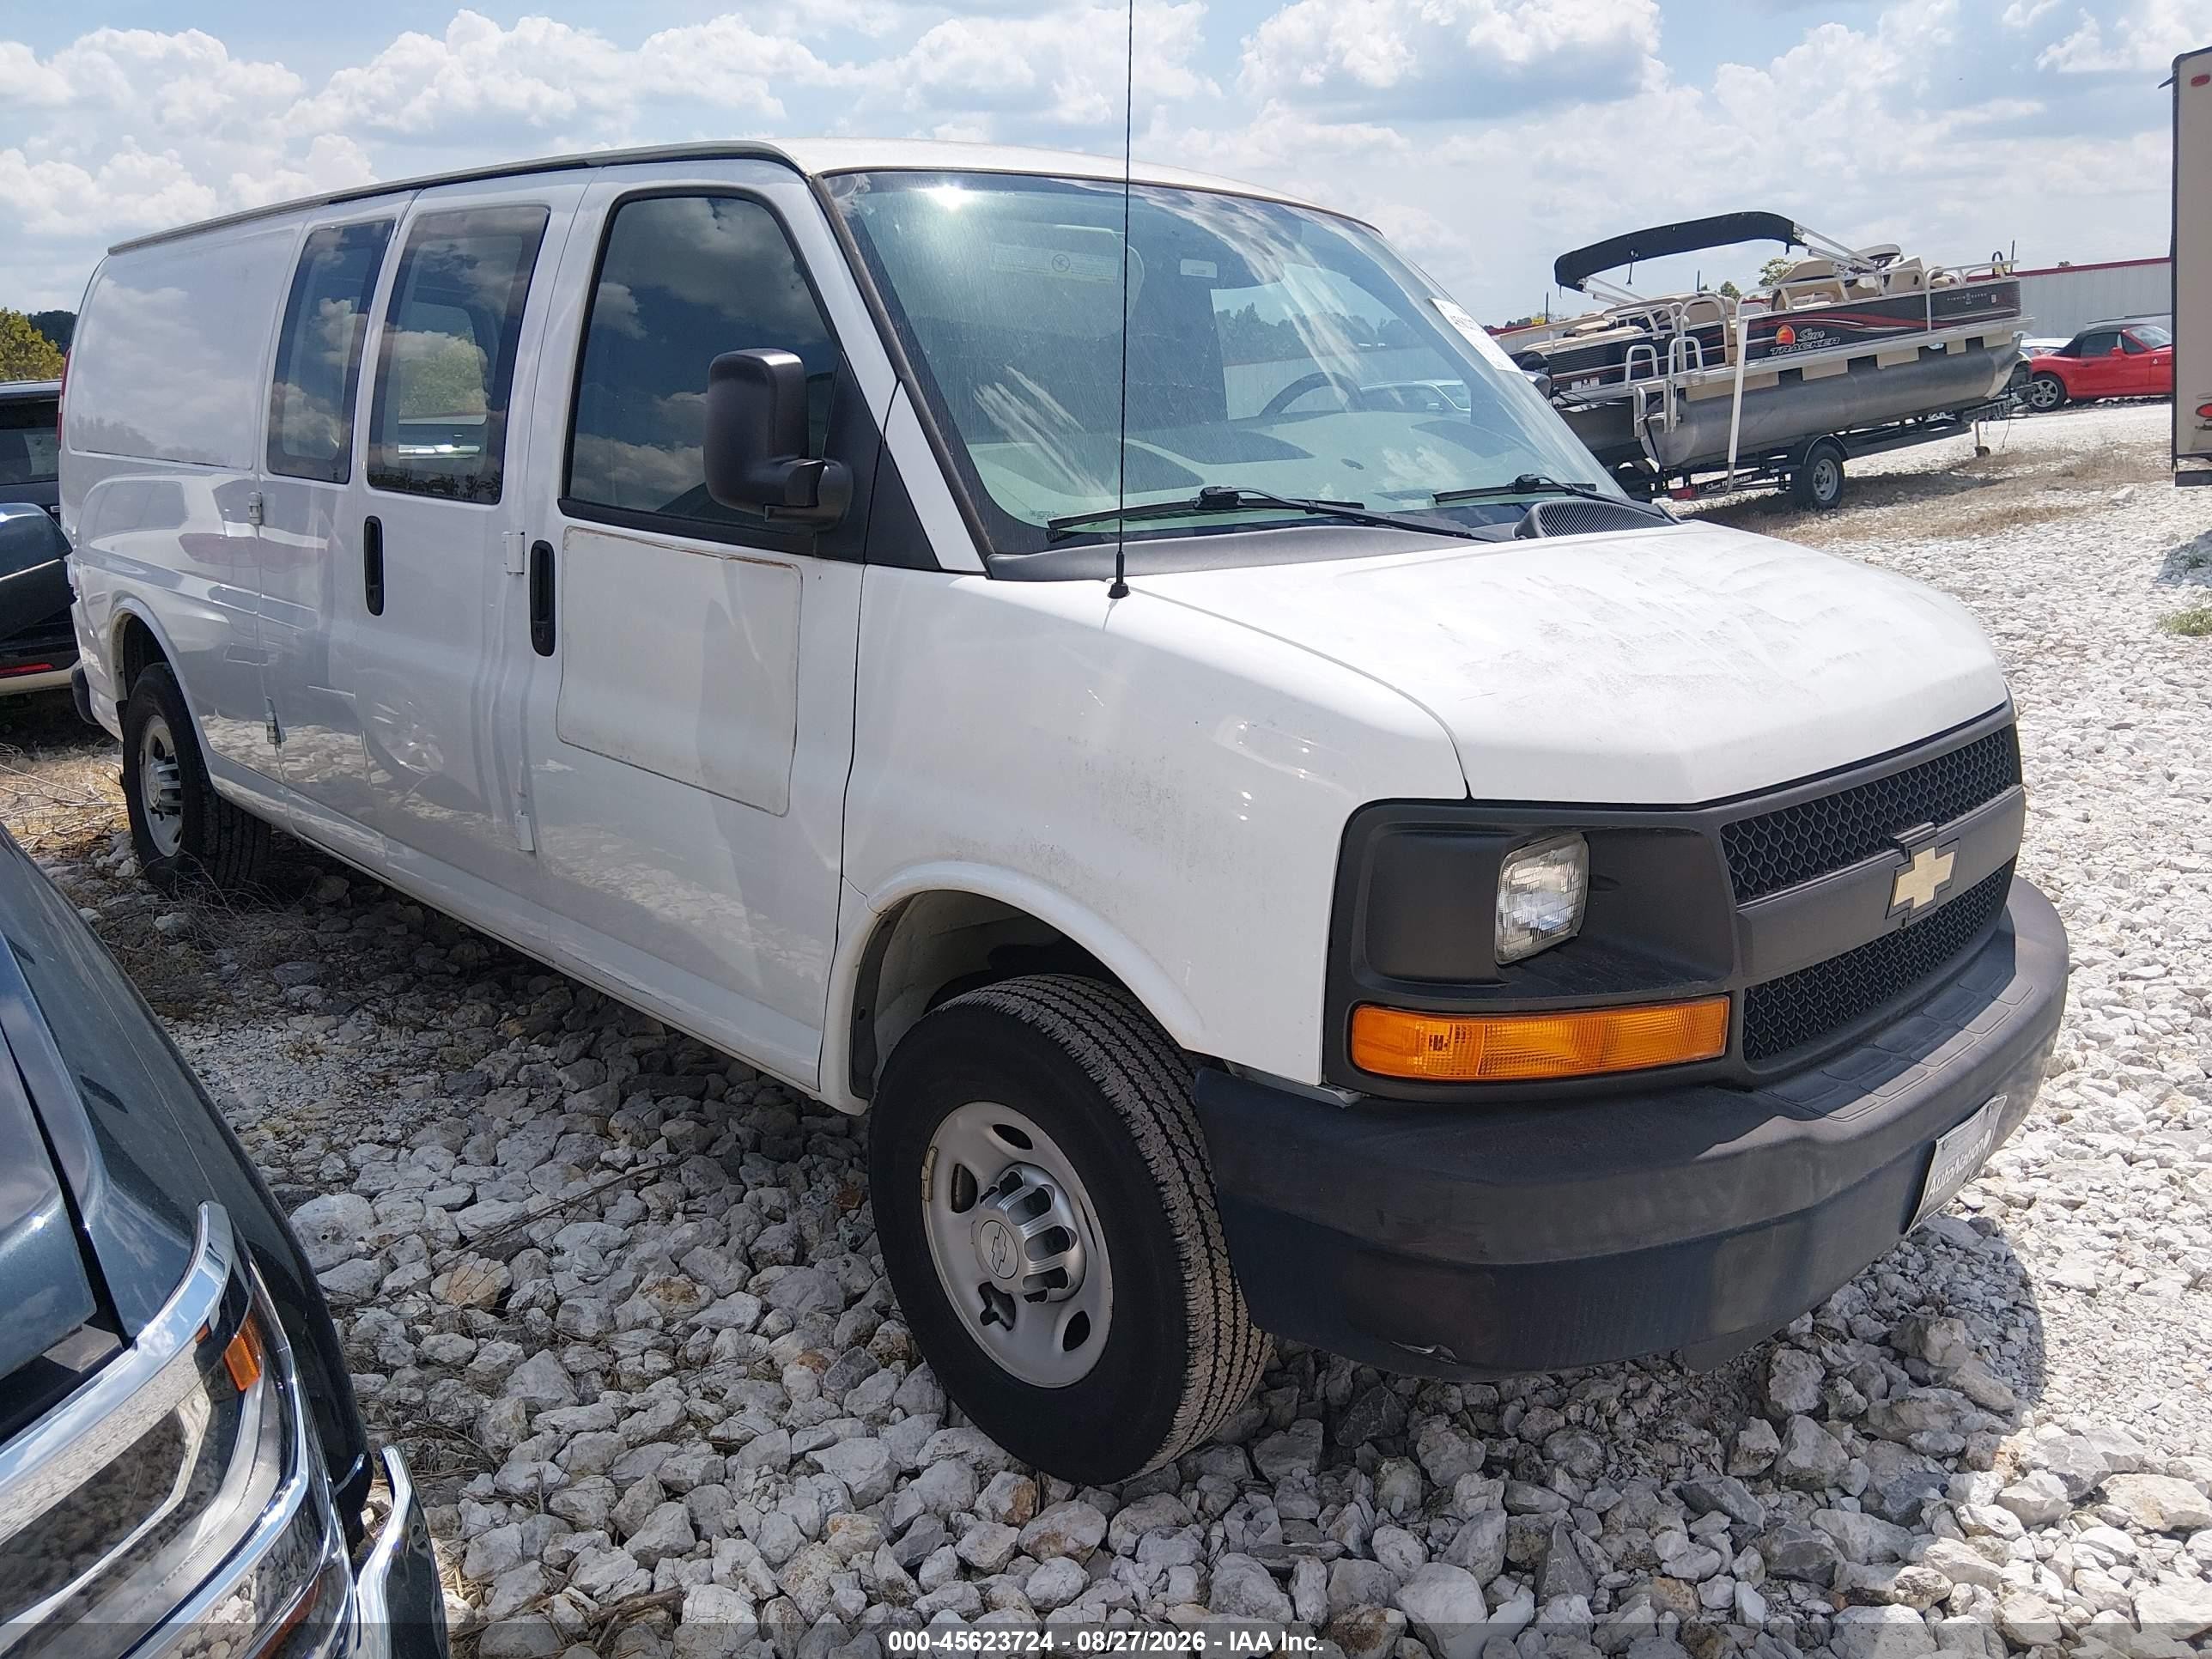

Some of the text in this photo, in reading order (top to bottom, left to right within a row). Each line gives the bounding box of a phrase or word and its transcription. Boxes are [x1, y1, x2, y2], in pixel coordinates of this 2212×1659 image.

[1797, 328, 1826, 342] Sun
[1770, 337, 1841, 356] TRACKER
[1722, 474, 1753, 487] TCKER
[1925, 1138, 1984, 1200] AutoNation
